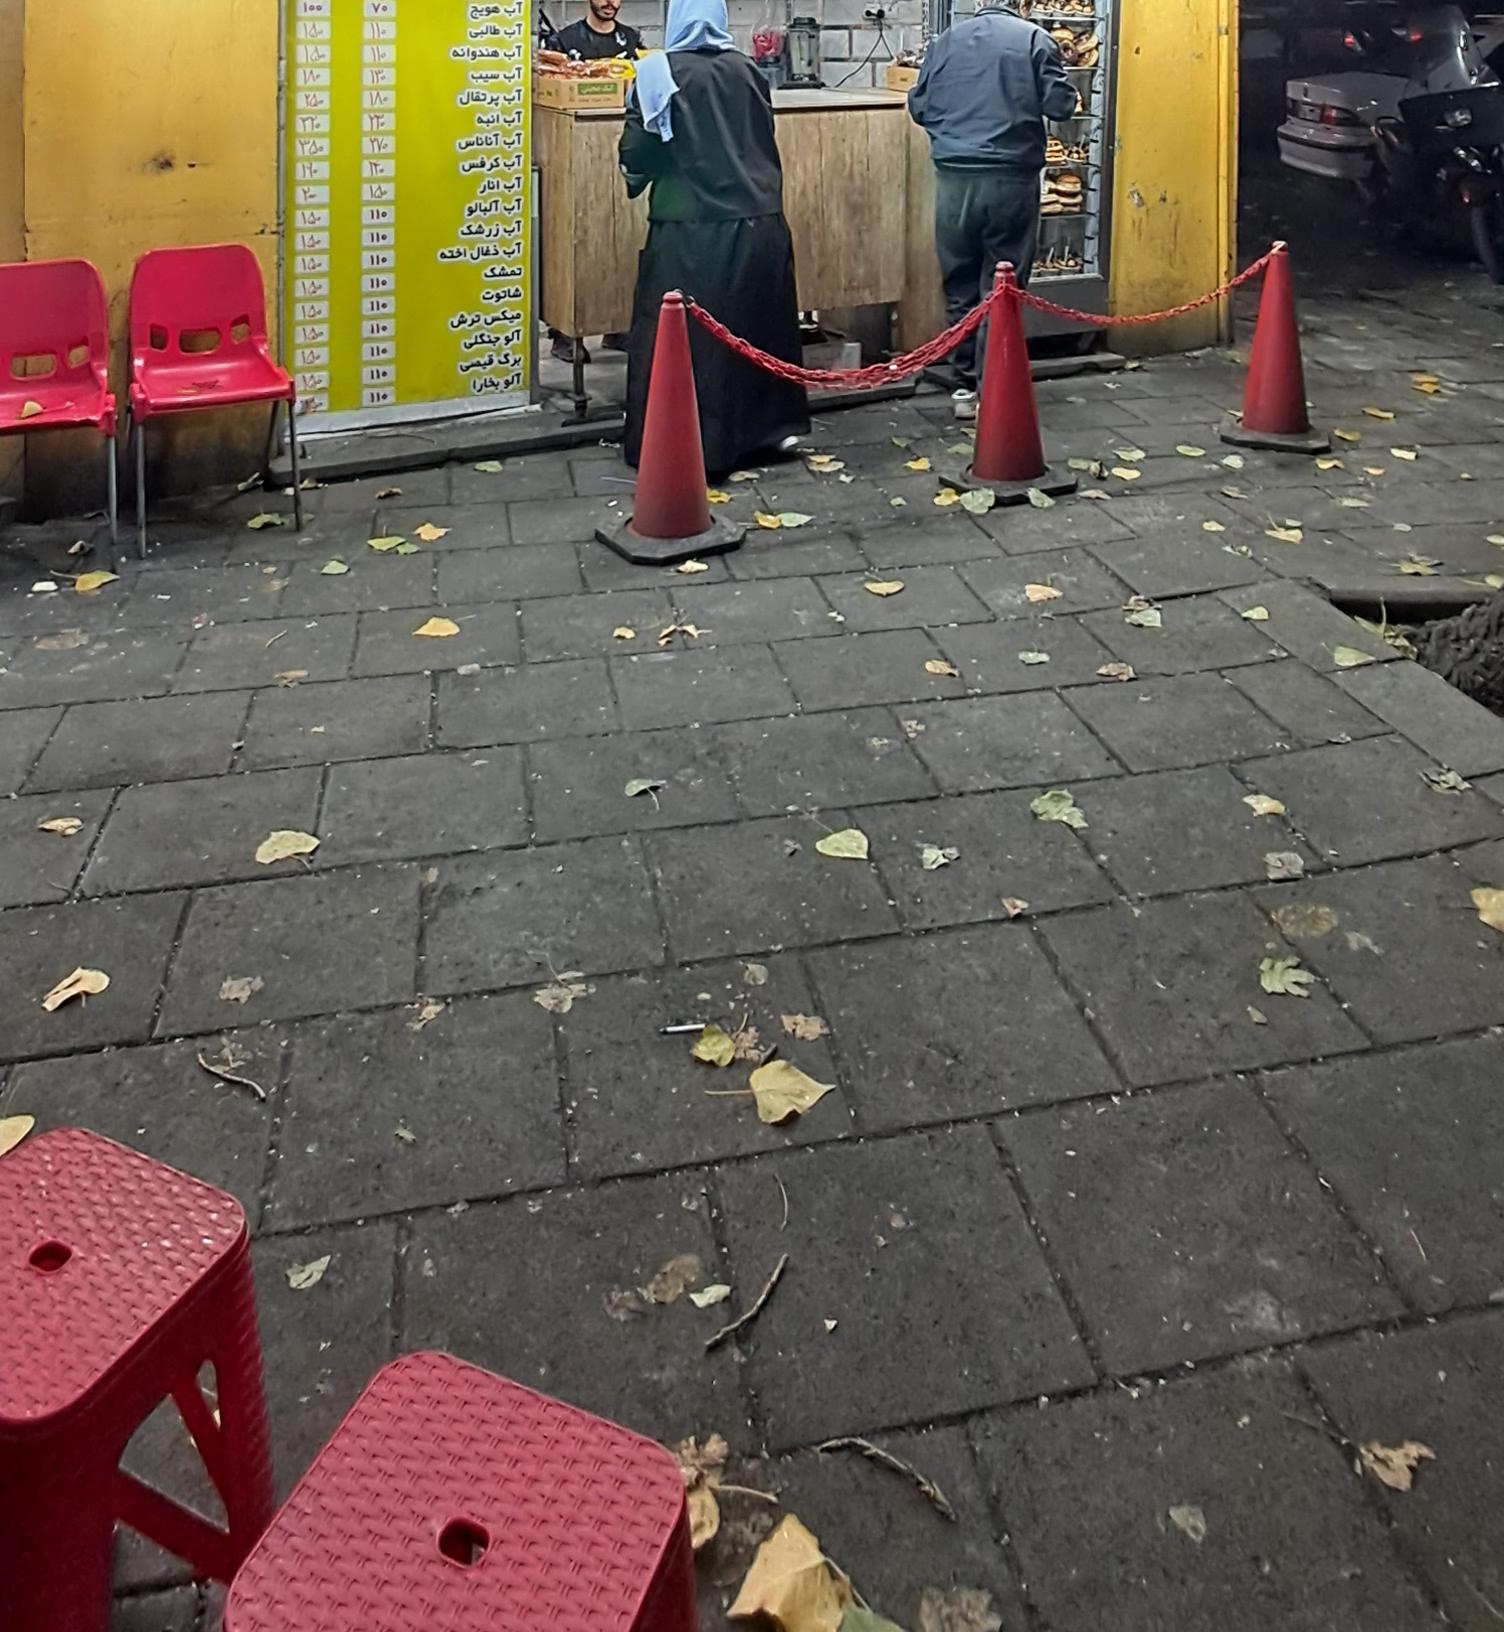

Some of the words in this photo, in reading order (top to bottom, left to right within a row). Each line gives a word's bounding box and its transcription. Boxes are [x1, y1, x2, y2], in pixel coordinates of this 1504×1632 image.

[304, 3, 322, 13] ۱۰۰
[372, 3, 387, 13] ۷۰
[471, 6, 500, 19] هویج
[504, 2, 522, 16] آب
[469, 25, 500, 38] طالبی
[504, 24, 522, 38] آب
[452, 48, 499, 60] هندوانه
[504, 45, 522, 60] آب
[471, 73, 499, 82] سیب
[504, 67, 522, 82] آب
[460, 91, 499, 106] پرتقال
[504, 89, 522, 104] آب
[477, 114, 499, 127] انبه
[504, 111, 522, 126] آب
[458, 134, 499, 149] آناناس
[504, 133, 522, 148] آب
[462, 157, 499, 172] کرفس
[504, 155, 522, 170] آب
[480, 180, 499, 194] انار
[504, 177, 522, 192] آب
[467, 200, 499, 216] آلبالو
[504, 199, 522, 214] آب
[370, 209, 387, 219] ۱۱۰
[461, 224, 499, 237] زرشک
[504, 220, 521, 236] آب
[370, 232, 387, 242] ۱۱۰
[440, 248, 466, 259] اخته
[471, 245, 499, 260] ذغال
[503, 242, 521, 258] آب
[370, 254, 387, 265] ۱۱۰
[484, 266, 522, 278] تمشک
[370, 278, 387, 288] ۱۱۰
[482, 287, 521, 302] شاتوت
[370, 300, 387, 311] ۱۱۰
[451, 314, 480, 328] ترش
[485, 310, 521, 325] میکس
[370, 323, 387, 334] ۱۱۰
[464, 333, 500, 349] جنگلی
[504, 329, 521, 345] آلو
[370, 347, 387, 357] ۱۱۰
[498, 353, 521, 367] برگ
[370, 370, 387, 380] ۱۱۰
[504, 373, 521, 388] آلو
[473, 378, 499, 392] بخارا
[370, 392, 387, 403] ۱۱۰
